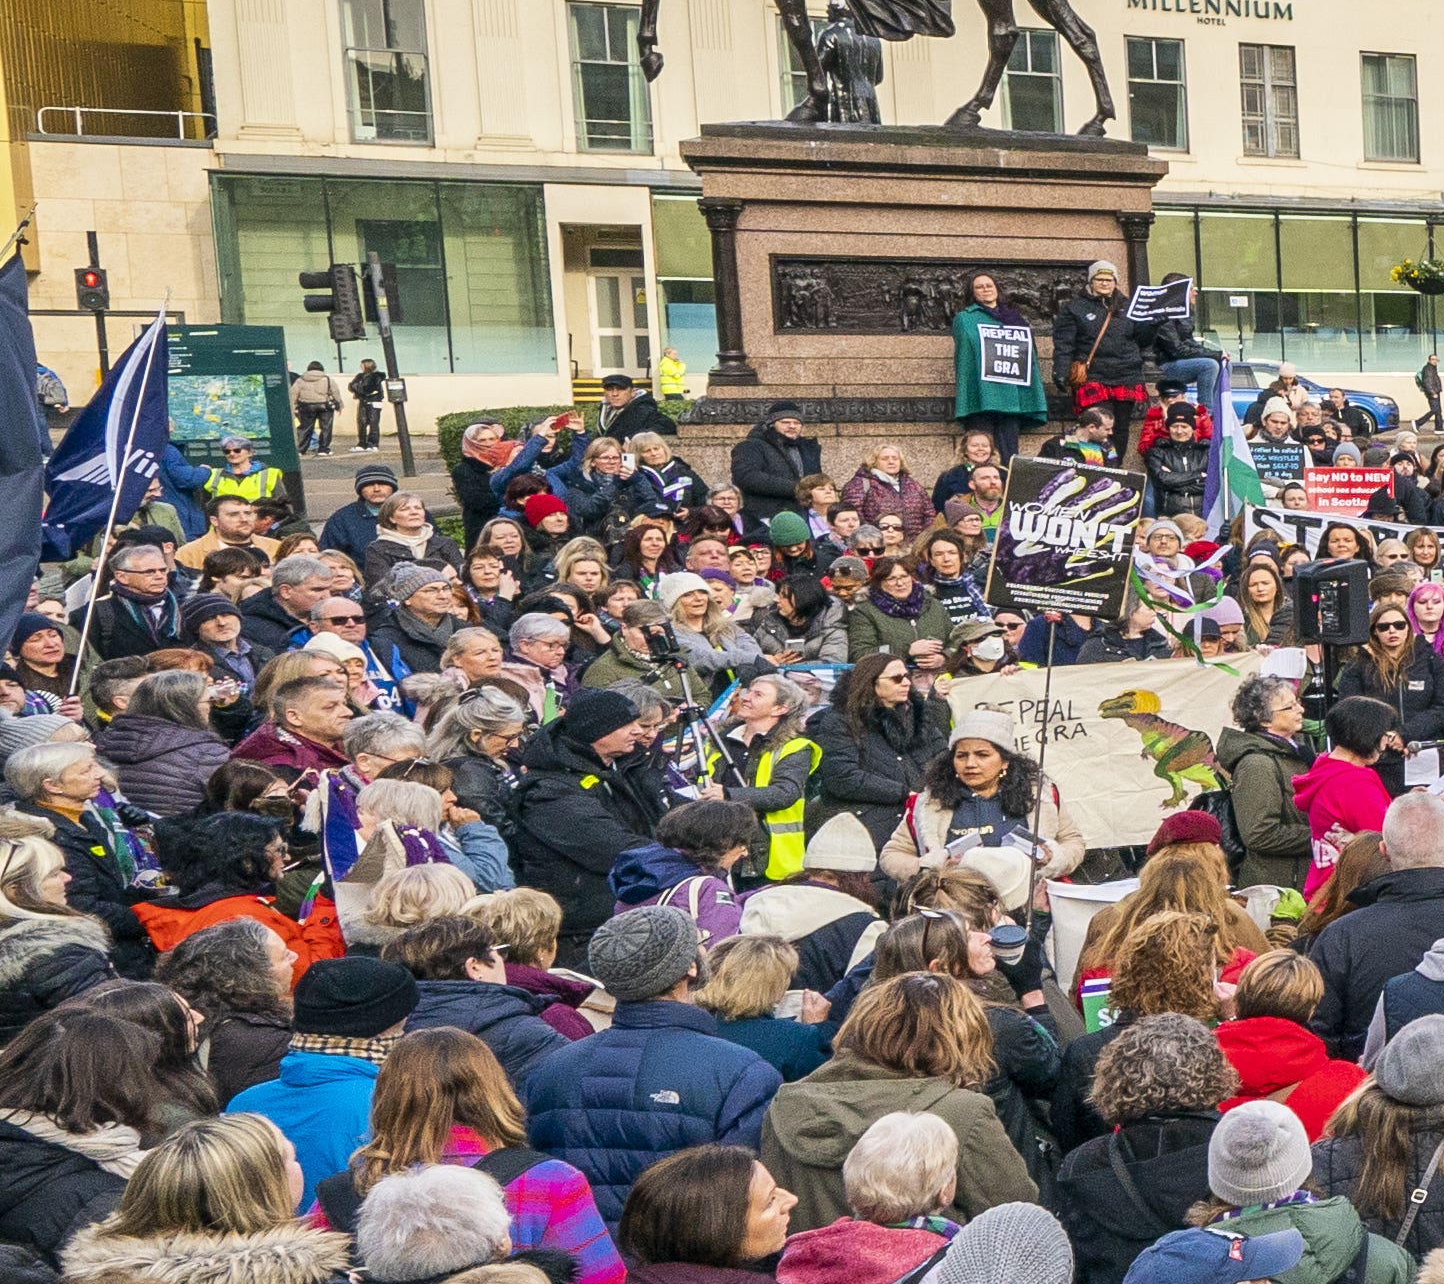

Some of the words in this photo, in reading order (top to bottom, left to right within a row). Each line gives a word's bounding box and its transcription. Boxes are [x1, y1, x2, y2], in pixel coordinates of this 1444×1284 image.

[1197, 16, 1227, 27] HOTEL
[981, 328, 1028, 342] REPEAL
[994, 343, 1020, 358] THE
[993, 360, 1020, 376] GRA
[1268, 455, 1300, 463] WHISTLER
[1308, 472, 1330, 483] Say
[1331, 473, 1349, 482] NO
[1350, 473, 1362, 483] to
[1365, 473, 1391, 483] NEW
[1308, 485, 1335, 494] school
[1318, 497, 1329, 506] in
[1331, 497, 1370, 507] Scotla
[1008, 500, 1093, 521] WOMEN
[1008, 512, 1133, 555] WON'T
[1054, 546, 1130, 562] WHEESHT
[975, 699, 1082, 725] PEAL
